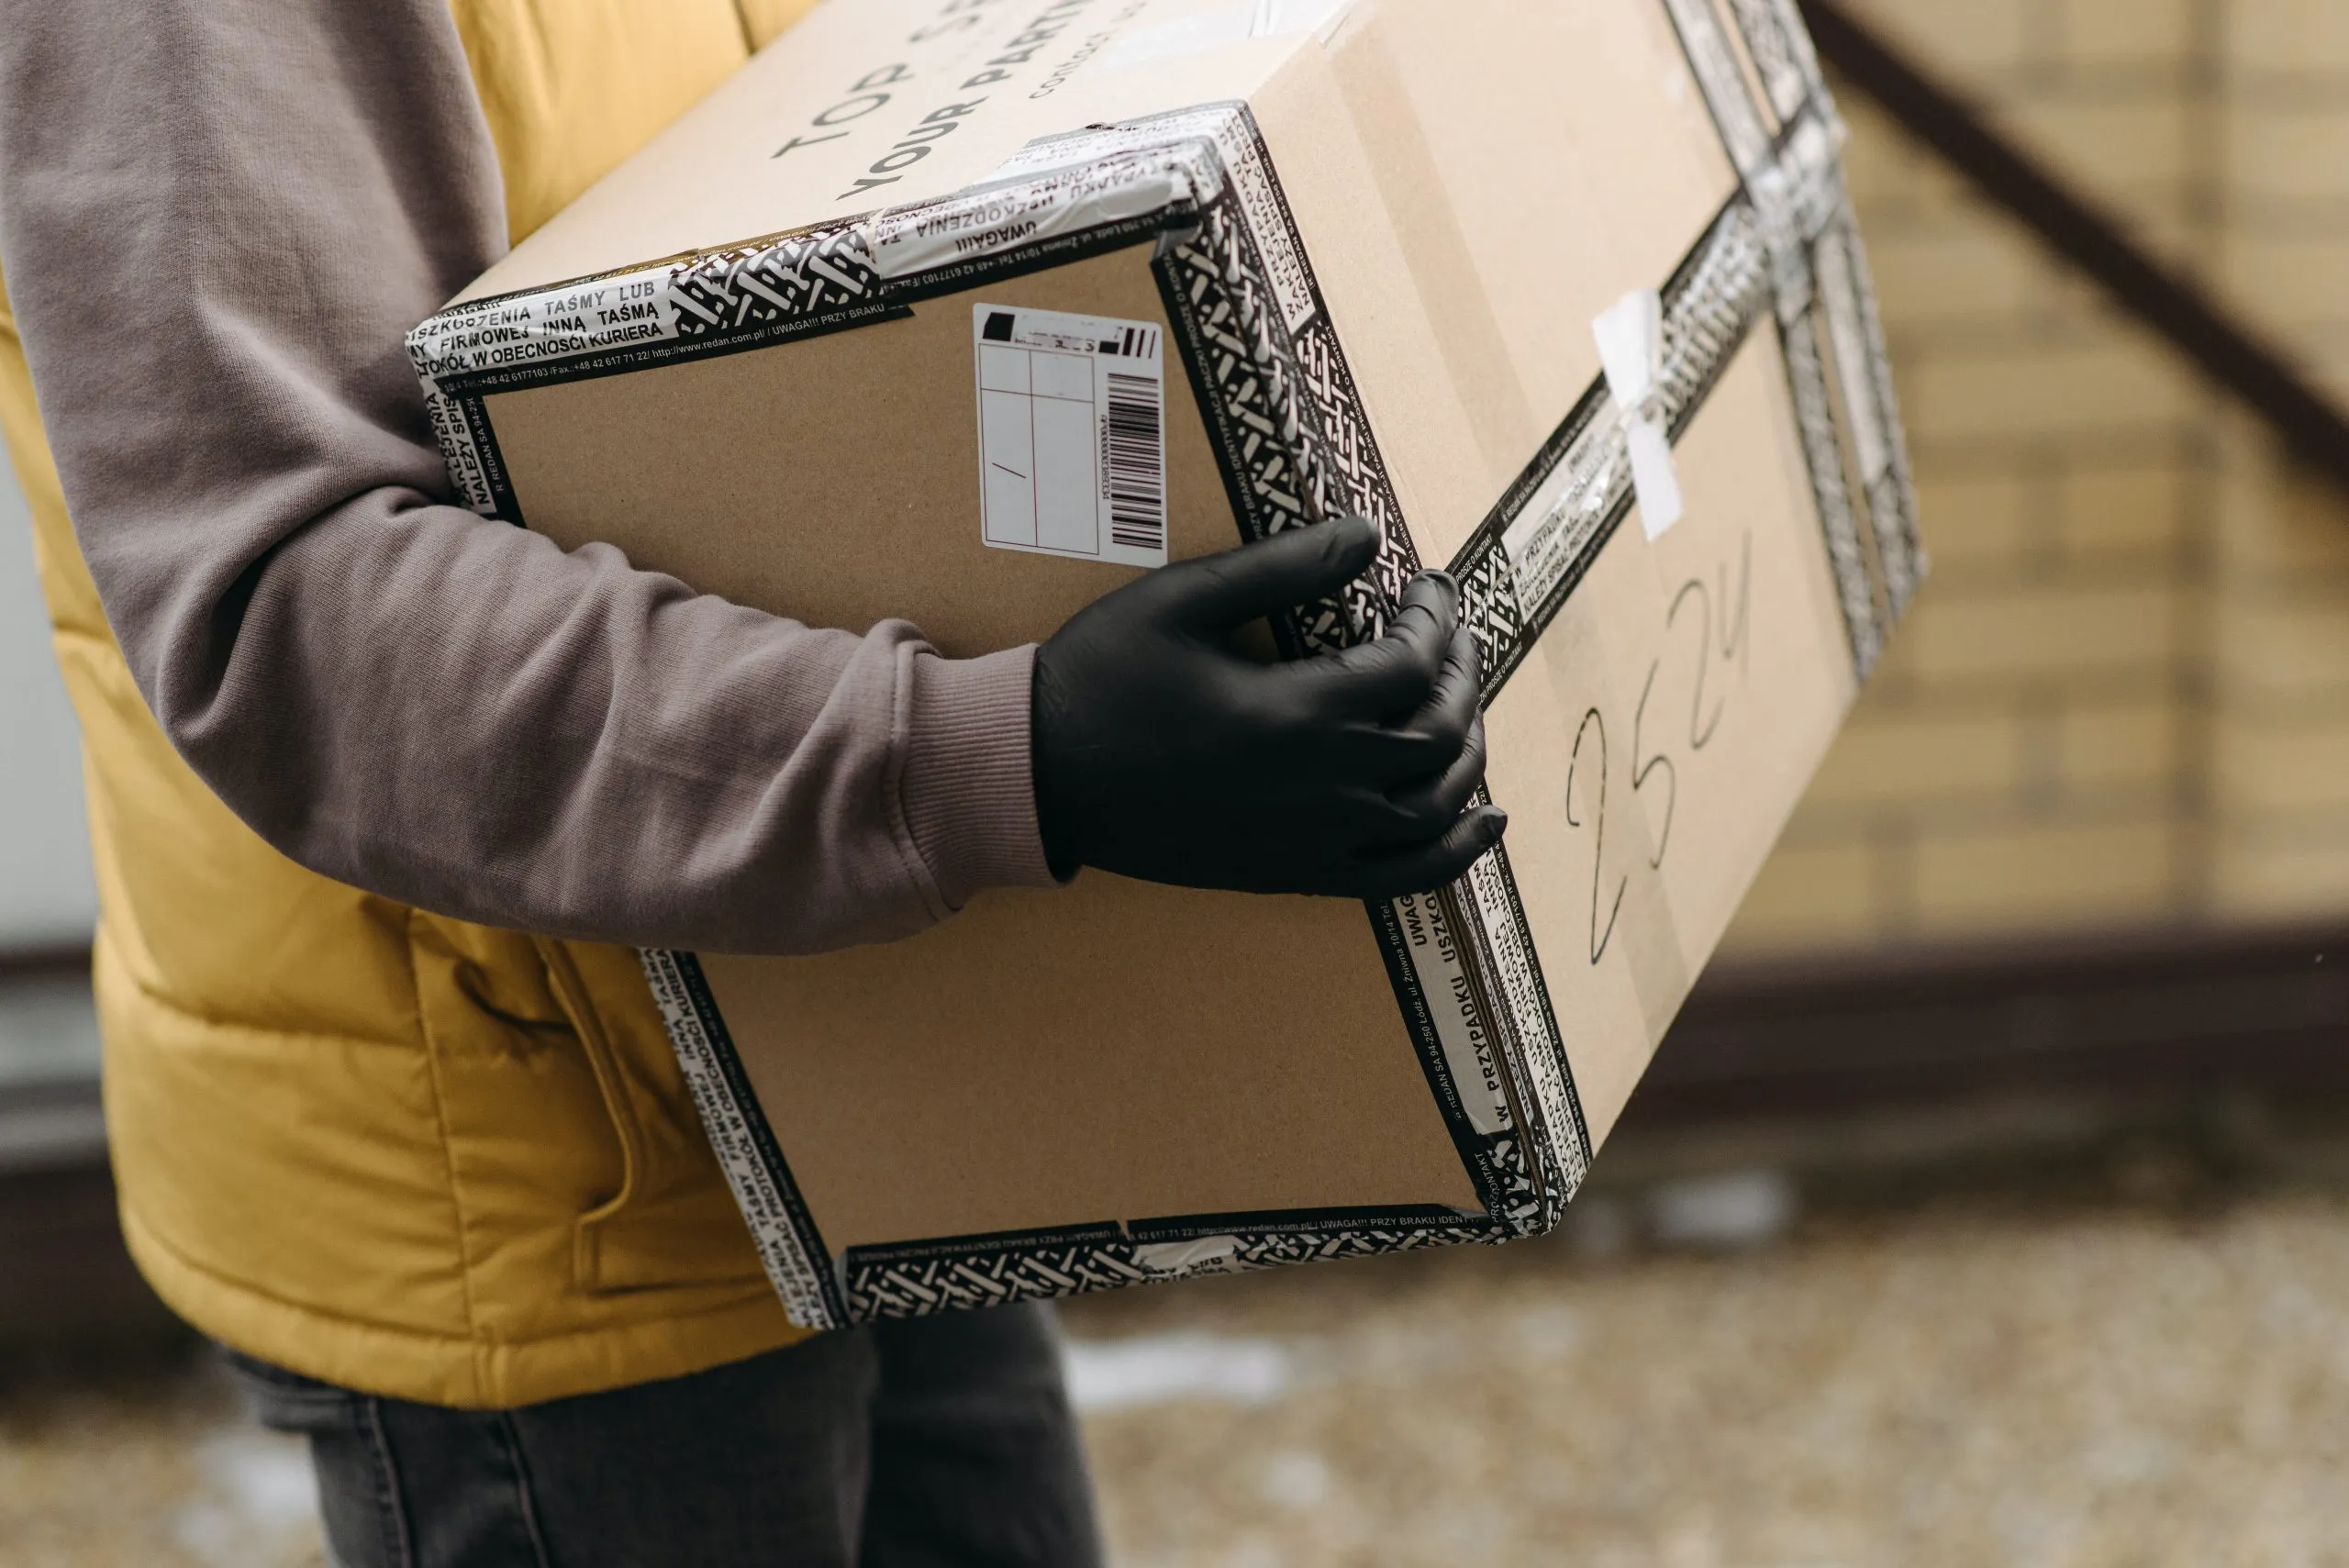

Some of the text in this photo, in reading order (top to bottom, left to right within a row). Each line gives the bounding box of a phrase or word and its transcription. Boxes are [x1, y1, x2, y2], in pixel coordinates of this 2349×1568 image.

[772, 63, 914, 159] TOP
[835, 96, 988, 200] YOUR
[1250, 164, 1286, 231] SPISAĆ
[1227, 160, 1289, 286] PRZYPADKU
[1248, 189, 1309, 312] ZAKLEJENIA
[1275, 234, 1314, 306] NALEŻY
[543, 287, 607, 317] TAŚMY
[618, 280, 655, 302] LUB
[921, 266, 962, 284] 6177103
[438, 321, 529, 357] FIRMOWEJ
[540, 314, 586, 340] INNĄ
[596, 297, 659, 330] TAŚMĄ
[1285, 301, 1298, 320] W
[473, 351, 487, 366] W
[588, 318, 663, 350] KURIERA
[498, 373, 510, 384] 42
[510, 365, 549, 384] 6177103
[591, 358, 604, 369] 42
[604, 354, 622, 366] 617
[624, 352, 634, 362] 71
[772, 316, 819, 336] UWAGA!!!
[819, 310, 849, 326] PRZY
[848, 302, 885, 319] BRAKU
[1321, 322, 1349, 374] KONTAKT
[1342, 375, 1351, 385] O
[475, 428, 487, 443] SA
[1204, 388, 1248, 471] IDENTYFIKACJI
[1362, 430, 1383, 469] PACZKI
[454, 436, 492, 506] NALEŻY
[480, 443, 501, 481] REDAN
[1232, 470, 1258, 510] BRAKU
[1375, 468, 1414, 548] IDENTYFIKACJI
[1453, 531, 1496, 584] PROSZĘ O KONTAKT
[1383, 918, 1403, 948] 10/14
[1506, 894, 1530, 934] 6177103
[1520, 933, 1531, 947] 42
[1390, 946, 1416, 984] Żniwna
[1491, 920, 1540, 1017] FIRMOWEJ
[1518, 961, 1531, 979] W
[1482, 925, 1548, 1064] USZKODZENIA
[1534, 984, 1551, 1010] 10/14
[1419, 1023, 1442, 1059] 94-250
[1446, 973, 1506, 1092] PRZYPADKU
[1518, 979, 1563, 1071] PROTOKÓŁ
[1541, 1010, 1562, 1045] Żniwna
[1431, 1055, 1444, 1073] SA
[1527, 1030, 1559, 1092] TAŚMY
[1493, 1102, 1511, 1123] W
[1547, 1073, 1579, 1135] SPISAĆ
[1319, 1215, 1368, 1232] UWAGA!!!
[1369, 1216, 1397, 1228] PRZY
[1399, 1214, 1436, 1227] BRAKU
